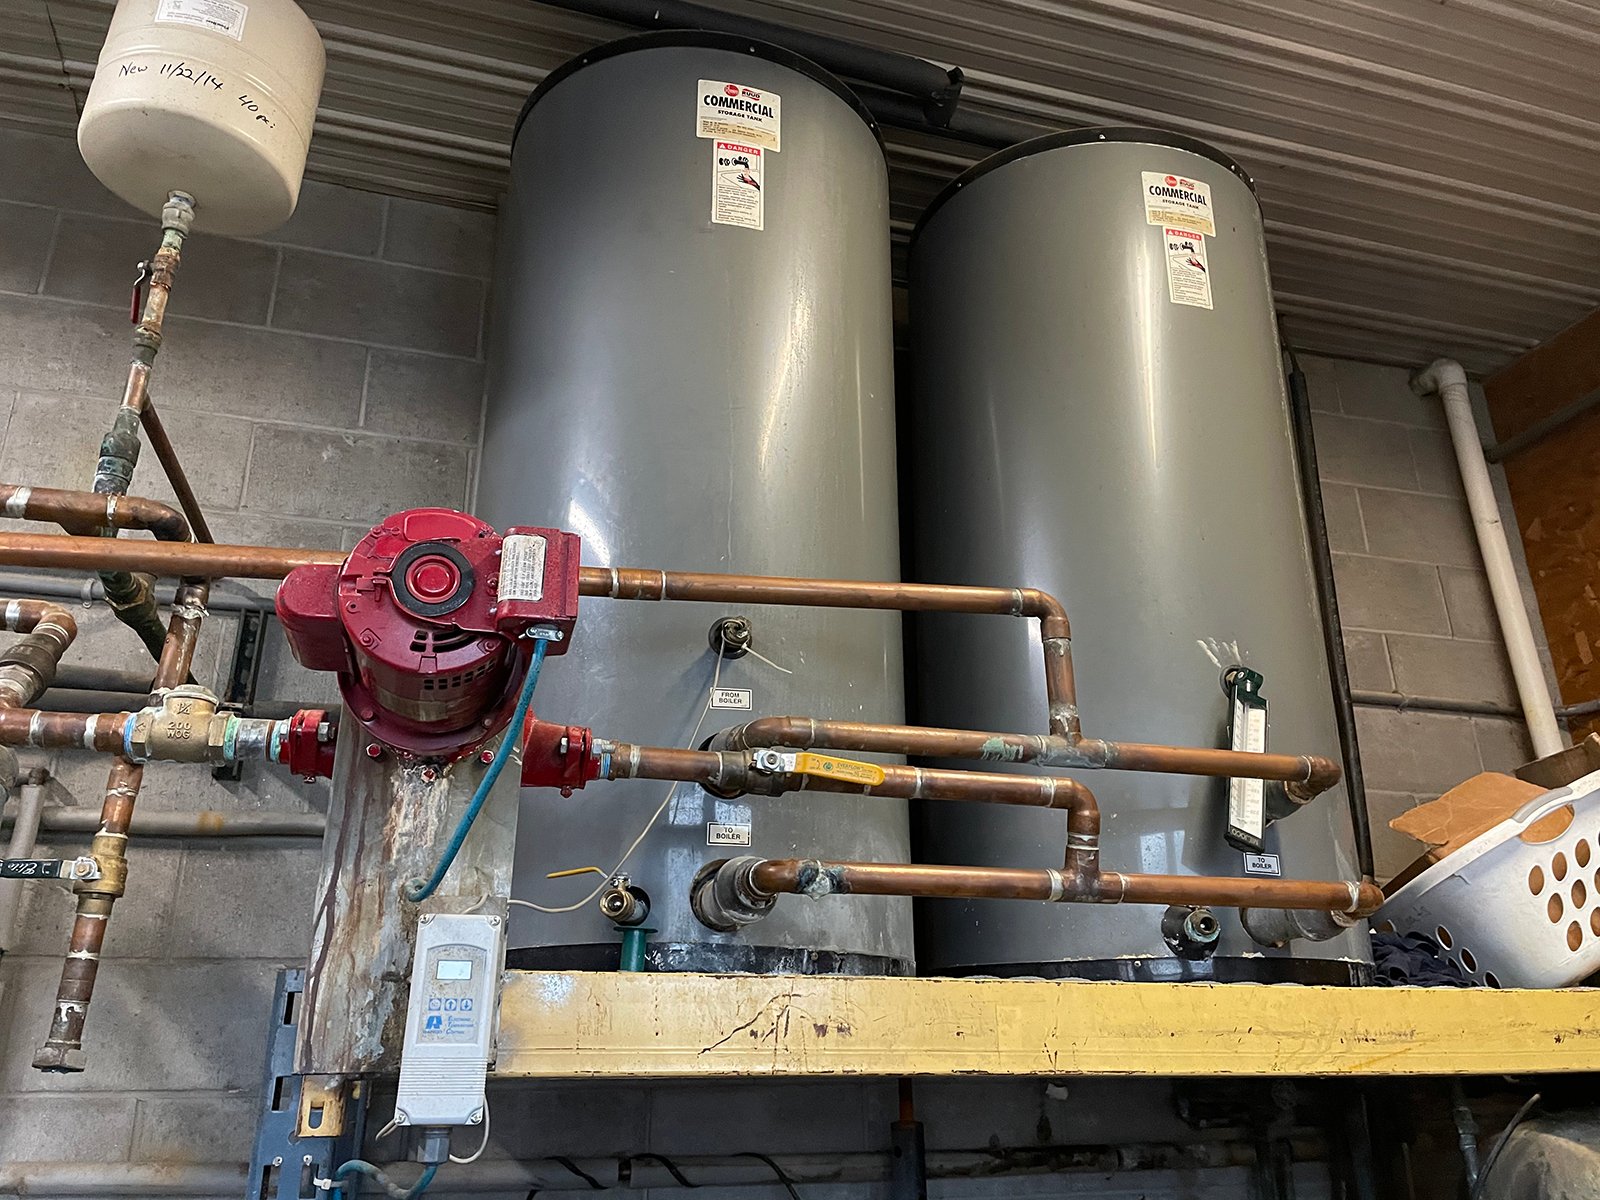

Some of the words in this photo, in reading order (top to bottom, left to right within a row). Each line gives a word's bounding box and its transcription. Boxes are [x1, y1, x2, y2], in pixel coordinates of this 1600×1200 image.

[118, 61, 148, 78] New
[159, 62, 224, 90] 11/22/14
[703, 94, 774, 118] COMMERCIAL
[718, 109, 745, 119] STORAGE
[747, 114, 763, 123] TANK
[726, 145, 759, 155] DANGER
[1149, 185, 1208, 206] COMMERCIAL
[1162, 199, 1186, 207] STORAGE
[1174, 231, 1202, 240] DANGER
[167, 721, 193, 731] 200
[166, 730, 191, 740] WOG
[723, 826, 734, 834] TO
[715, 832, 741, 840] BOILER
